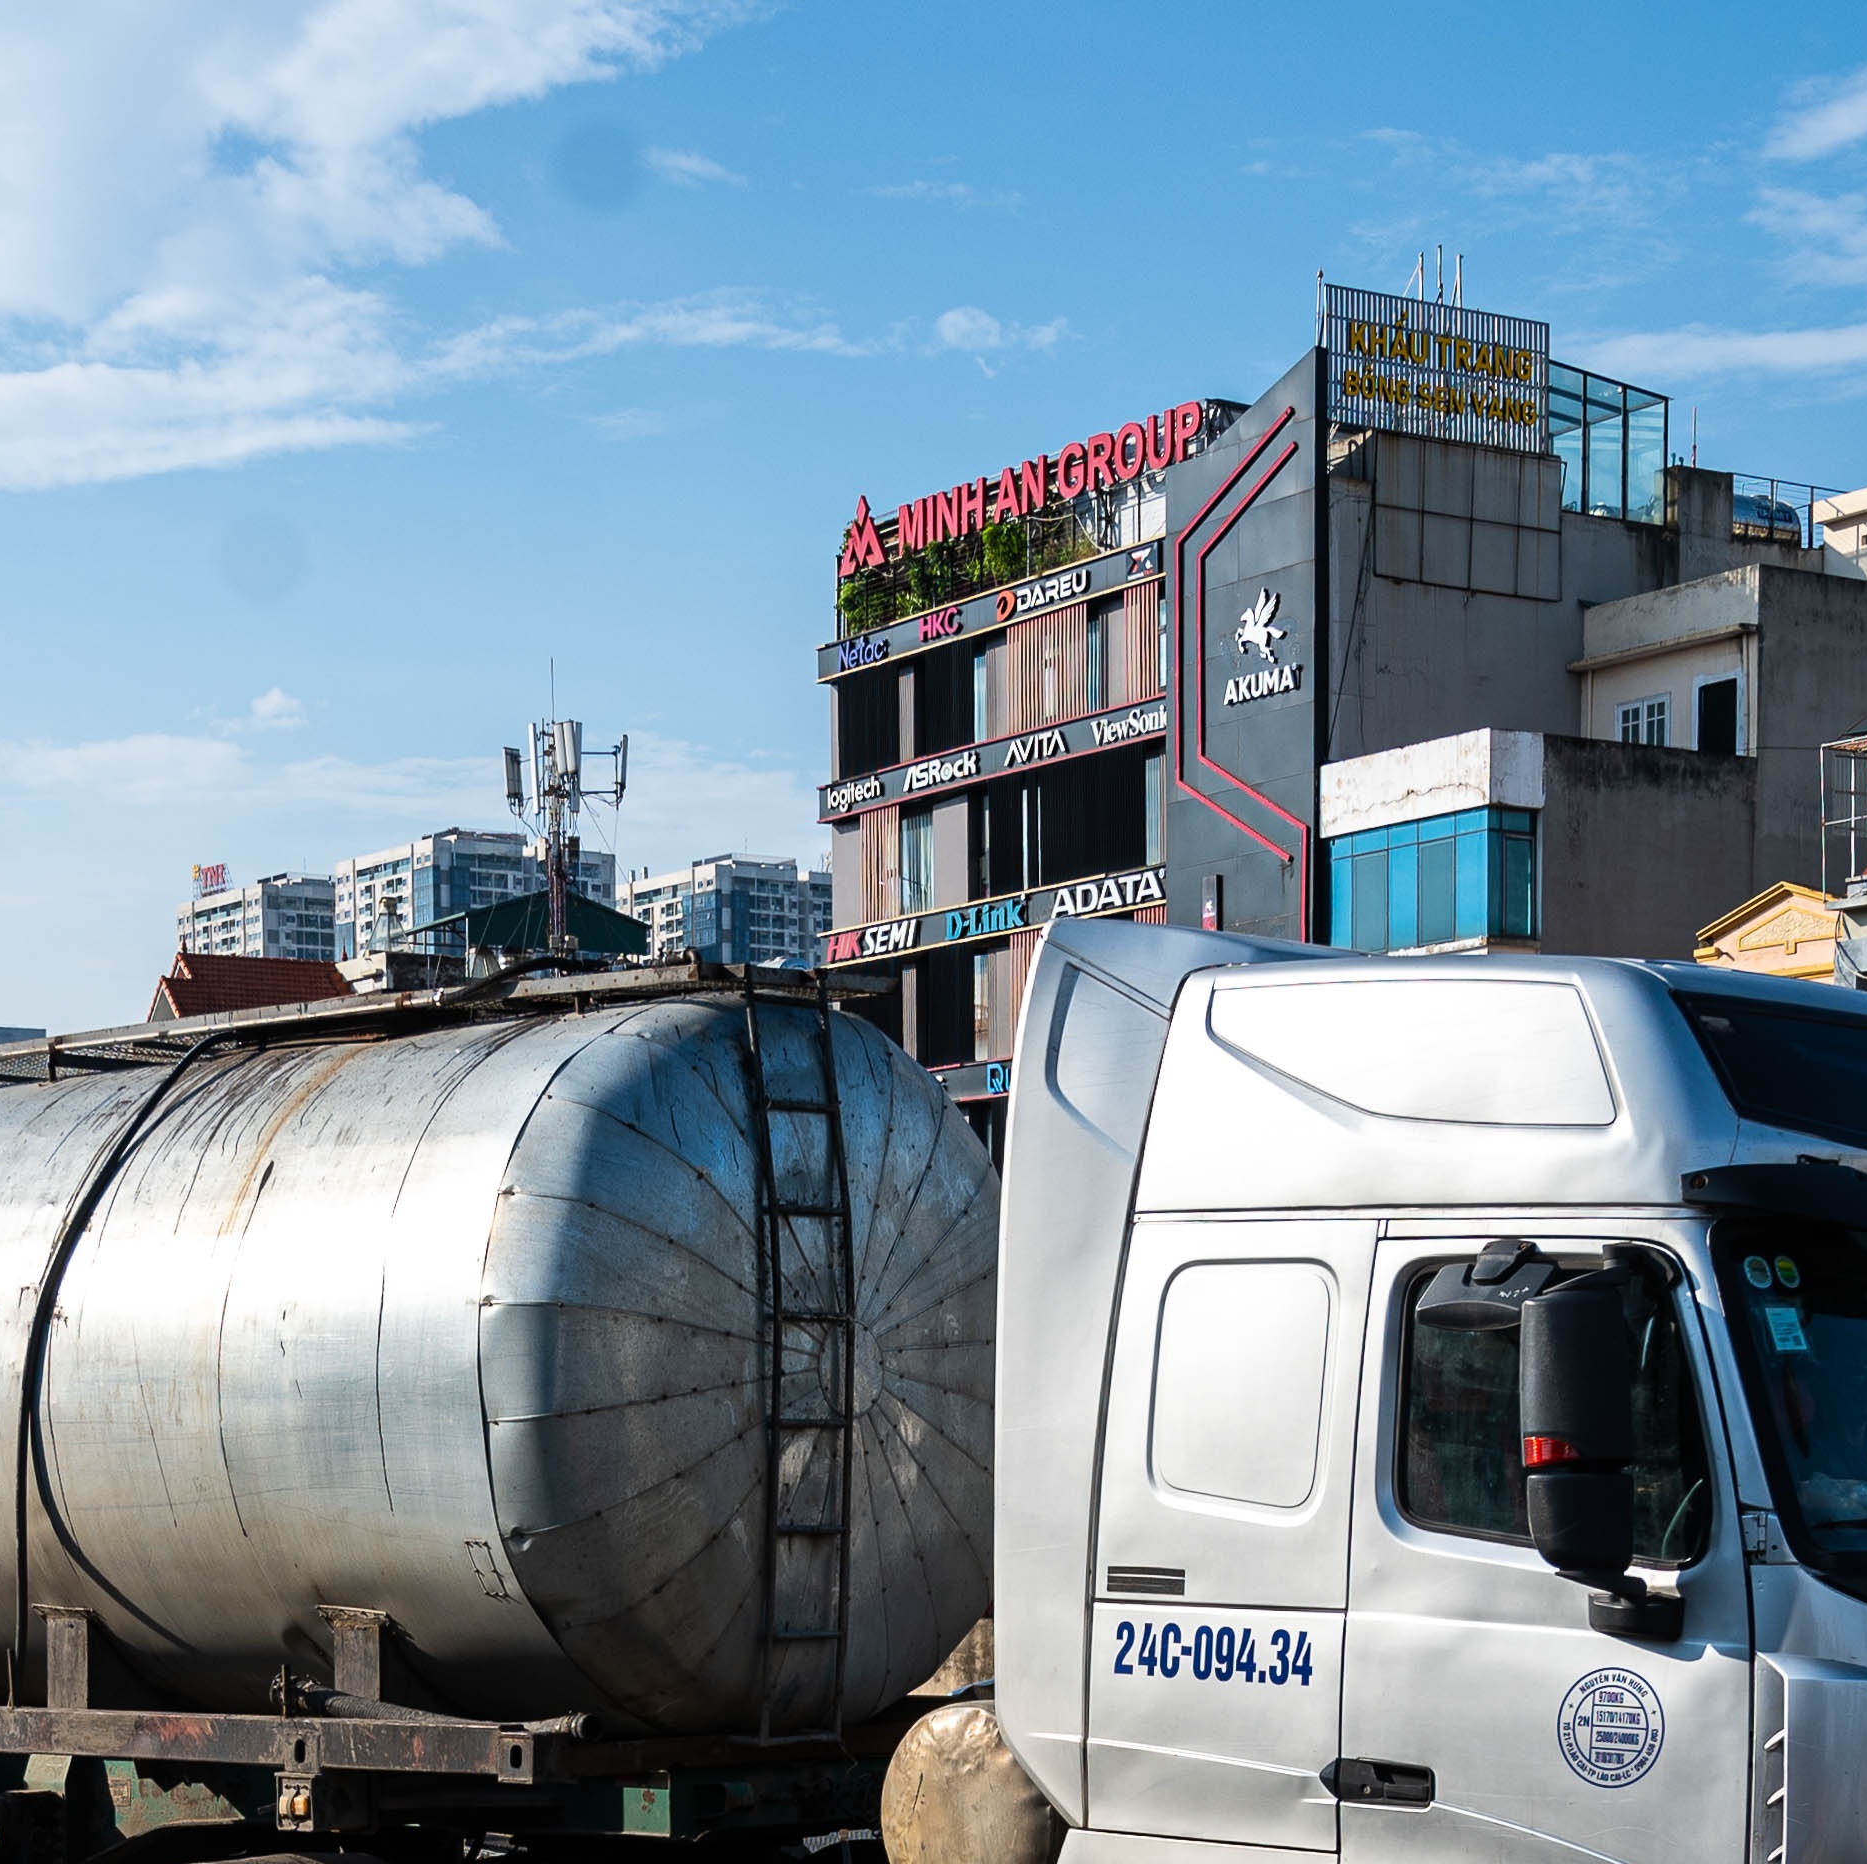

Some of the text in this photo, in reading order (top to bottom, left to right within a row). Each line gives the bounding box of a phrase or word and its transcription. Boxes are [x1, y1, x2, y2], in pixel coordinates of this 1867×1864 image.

[1349, 311, 1533, 382] KHẨU TRANG
[1417, 383, 1465, 414] SEN
[1471, 385, 1537, 425] VÀNG
[898, 400, 1203, 557] MINH AN GROUP
[1016, 569, 1088, 612] DAREU
[918, 607, 962, 642] HKC
[838, 636, 888, 672] Netac
[1223, 666, 1295, 706] AKUMA
[1004, 729, 1066, 767] AVITA
[902, 751, 978, 792] ASRock
[827, 776, 881, 812] logitech
[1050, 871, 1163, 918] ADATA
[826, 919, 918, 962] HIKSEMI
[945, 901, 1026, 940] D-Link
[1113, 1621, 1313, 1686] 24C-094.34
[1577, 1716, 1590, 1727] 2N
